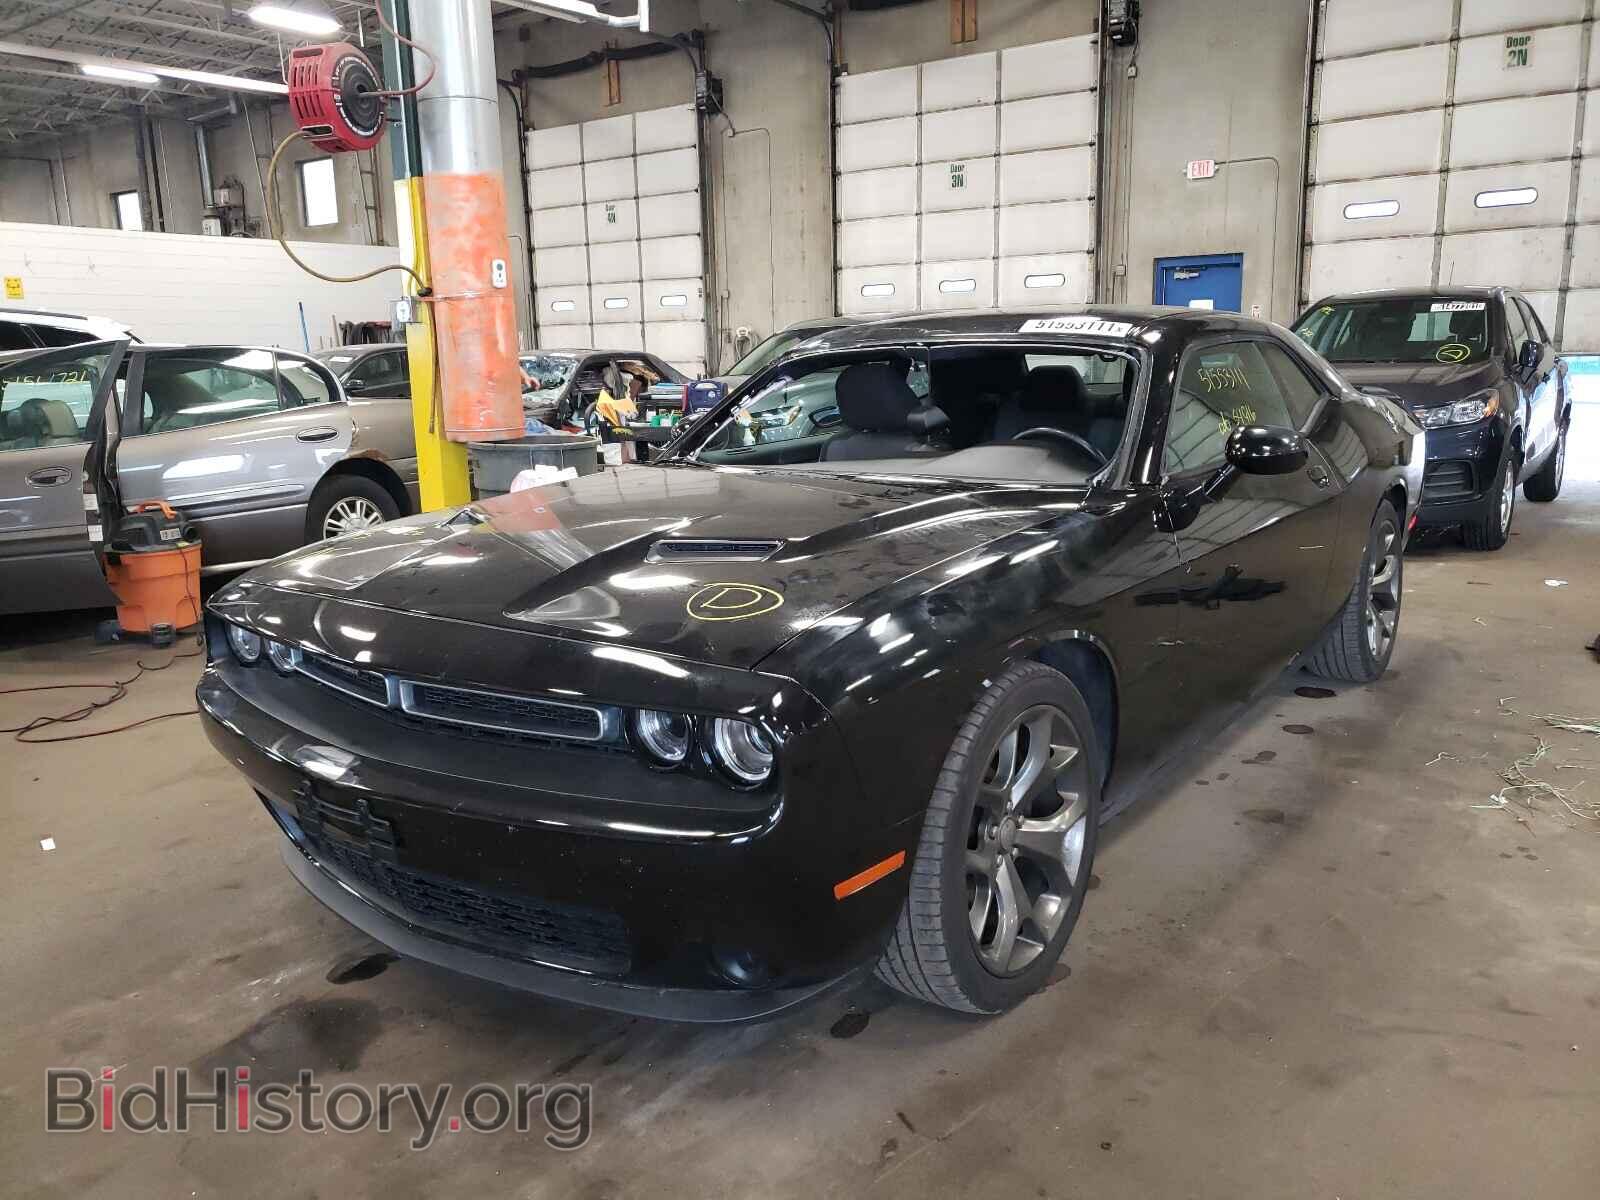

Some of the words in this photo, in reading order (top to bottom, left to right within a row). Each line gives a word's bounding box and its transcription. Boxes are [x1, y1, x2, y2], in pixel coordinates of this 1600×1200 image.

[1506, 36, 1532, 48] Door
[1507, 49, 1528, 67] 2N
[1191, 161, 1212, 176] EXIT
[951, 174, 964, 188] 3N
[1198, 368, 1252, 392] 51553111
